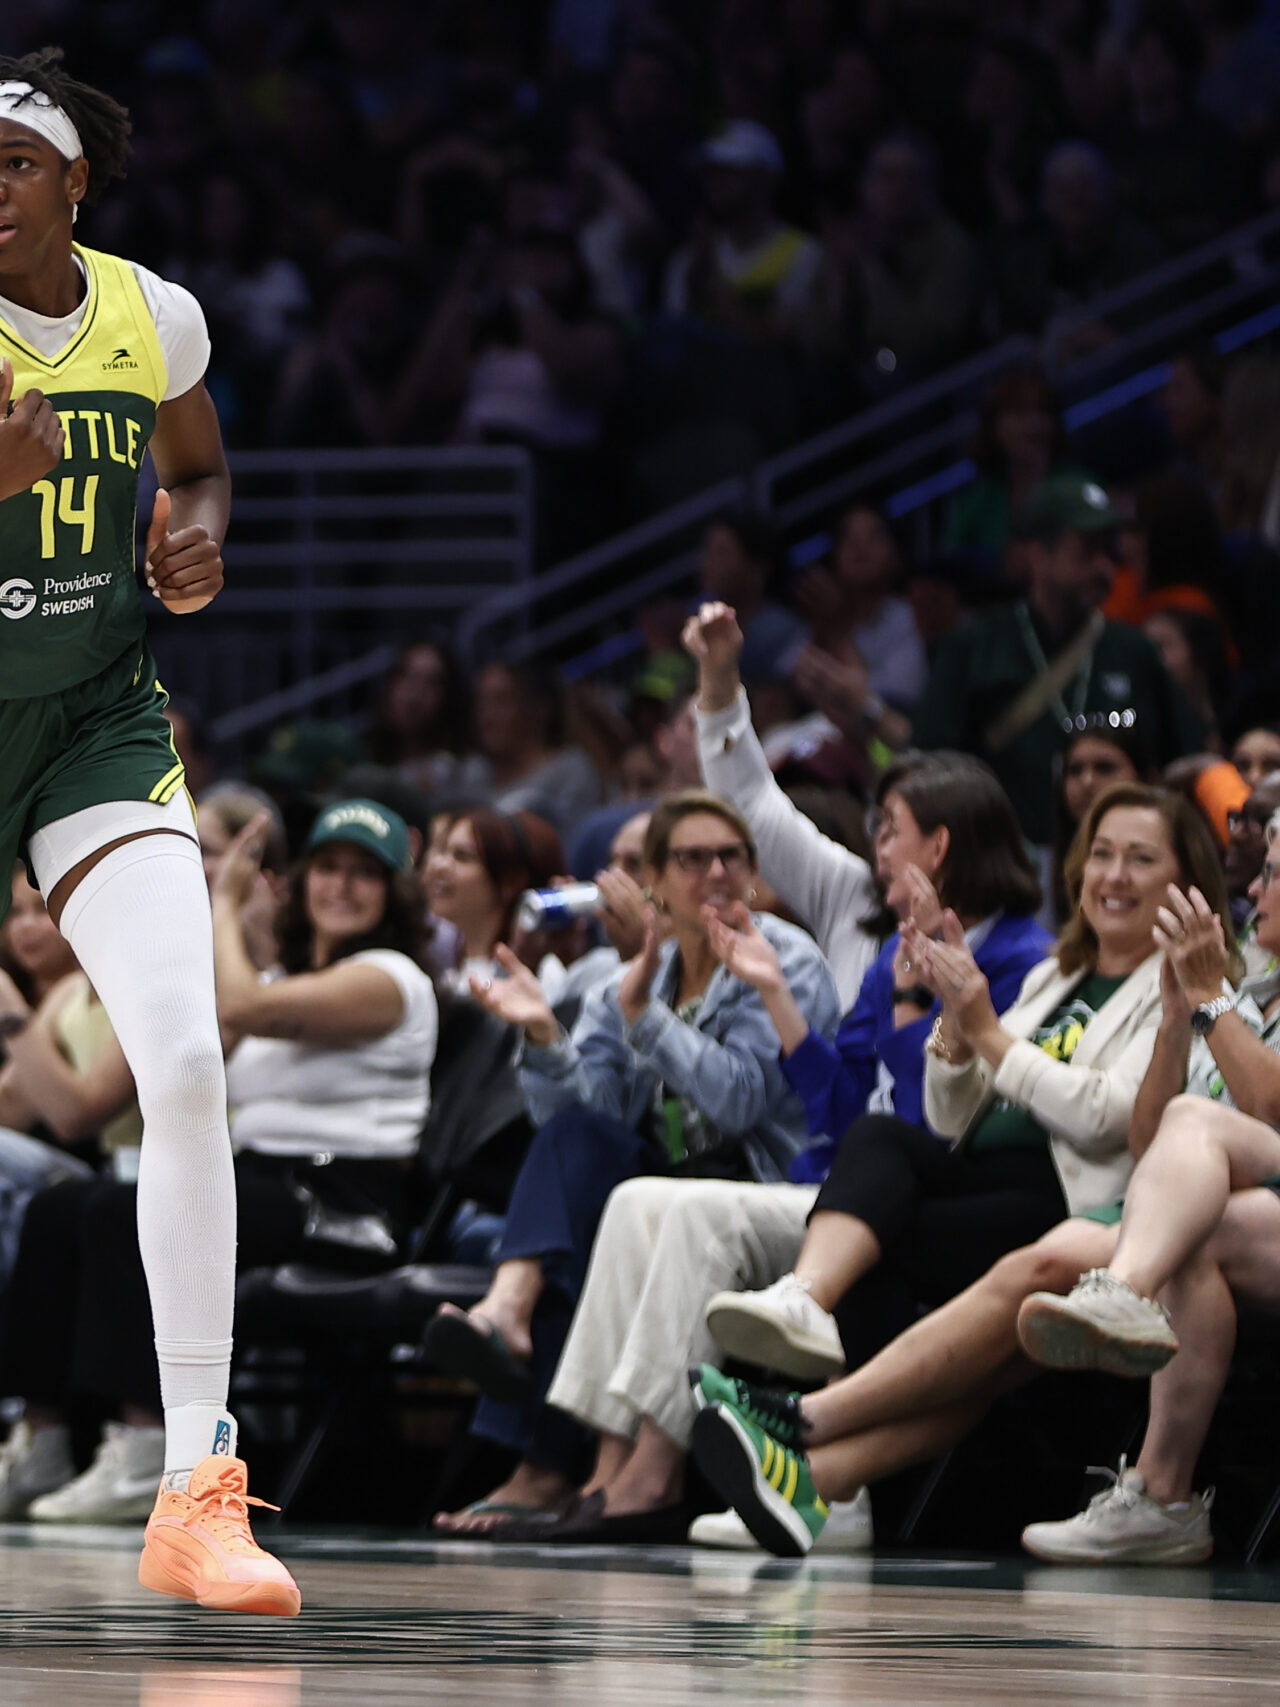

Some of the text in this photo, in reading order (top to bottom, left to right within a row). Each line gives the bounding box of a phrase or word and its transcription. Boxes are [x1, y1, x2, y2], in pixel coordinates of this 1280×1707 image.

[101, 361, 139, 371] SYMETRA
[31, 474, 100, 559] 14
[43, 572, 113, 595] Providence
[41, 595, 95, 617] SWEDISH
